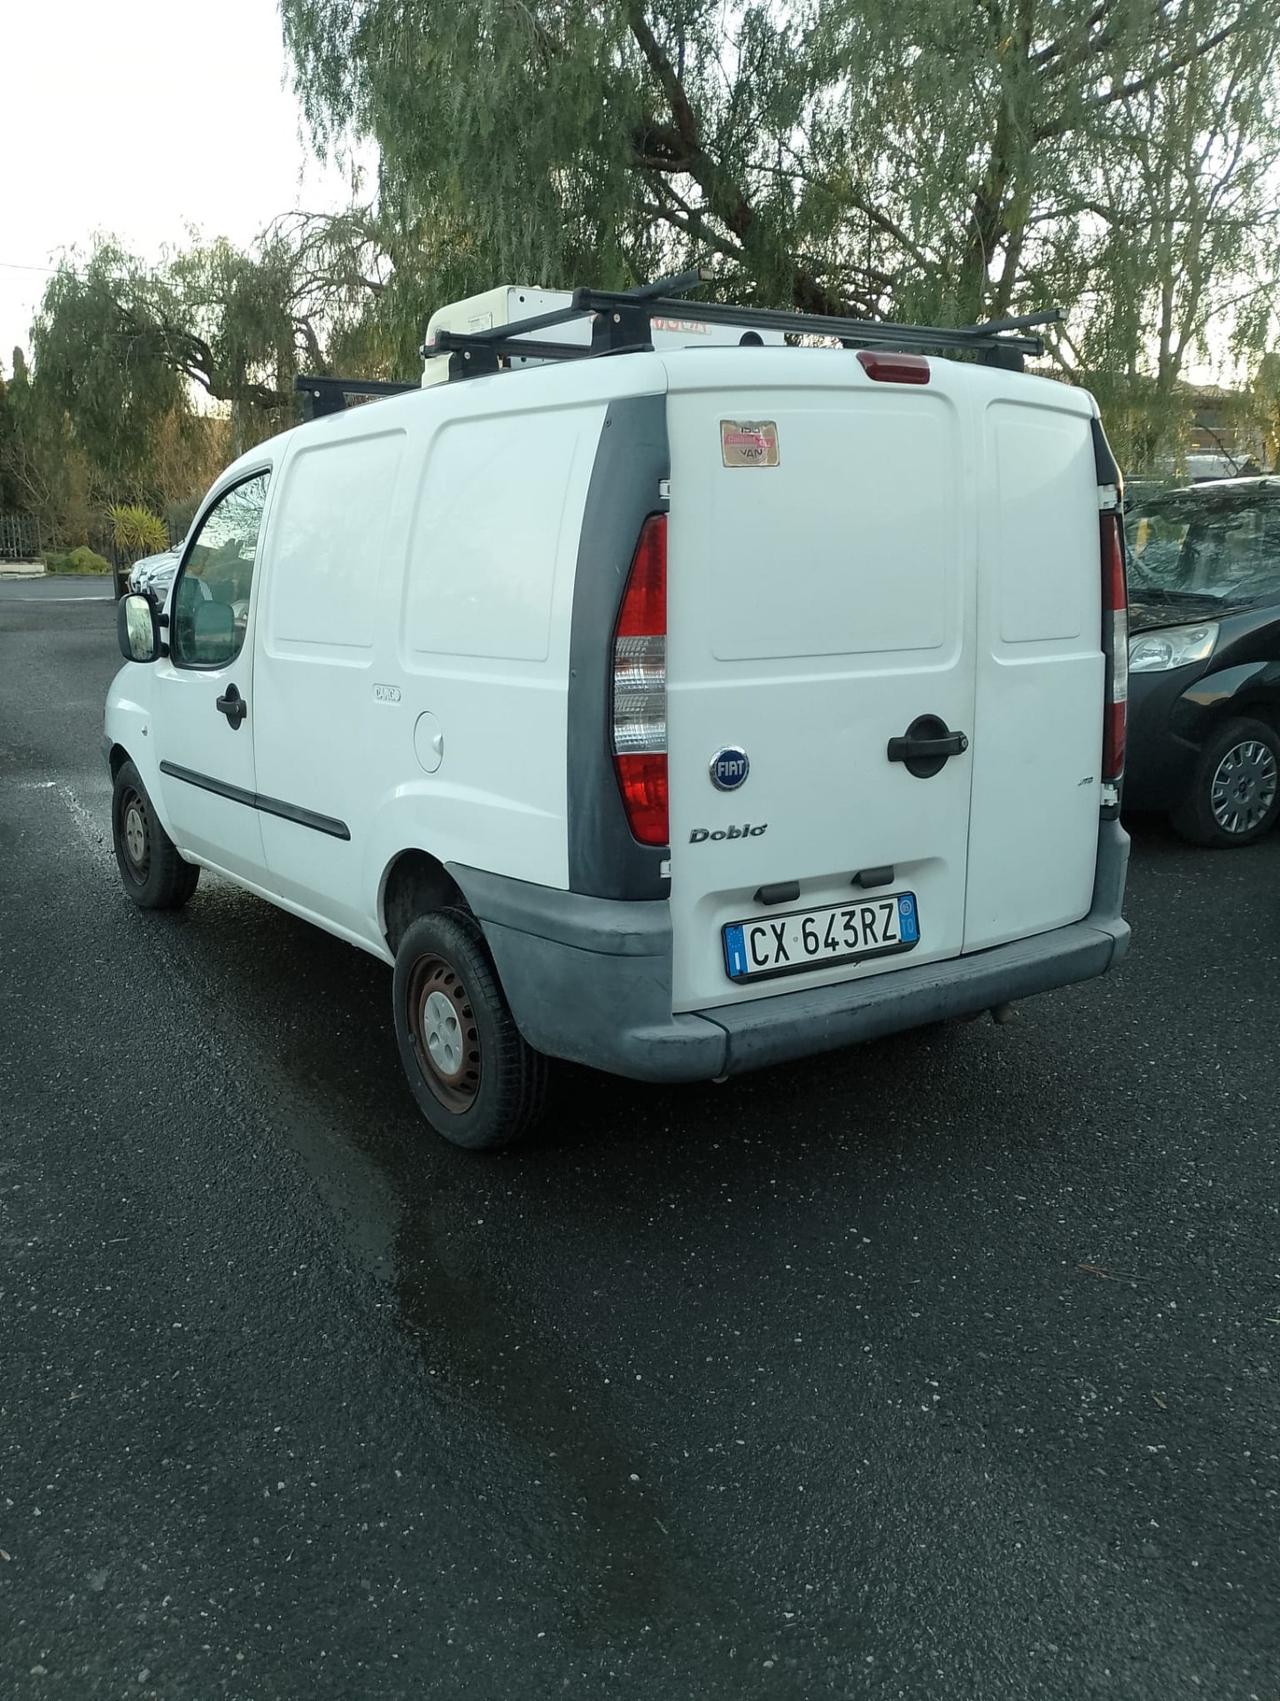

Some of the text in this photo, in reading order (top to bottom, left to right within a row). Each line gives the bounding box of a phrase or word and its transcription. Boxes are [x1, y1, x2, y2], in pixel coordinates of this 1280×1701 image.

[739, 448, 763, 459] VAN
[717, 759, 745, 777] FIAT
[749, 902, 898, 967] CX 643RZ
